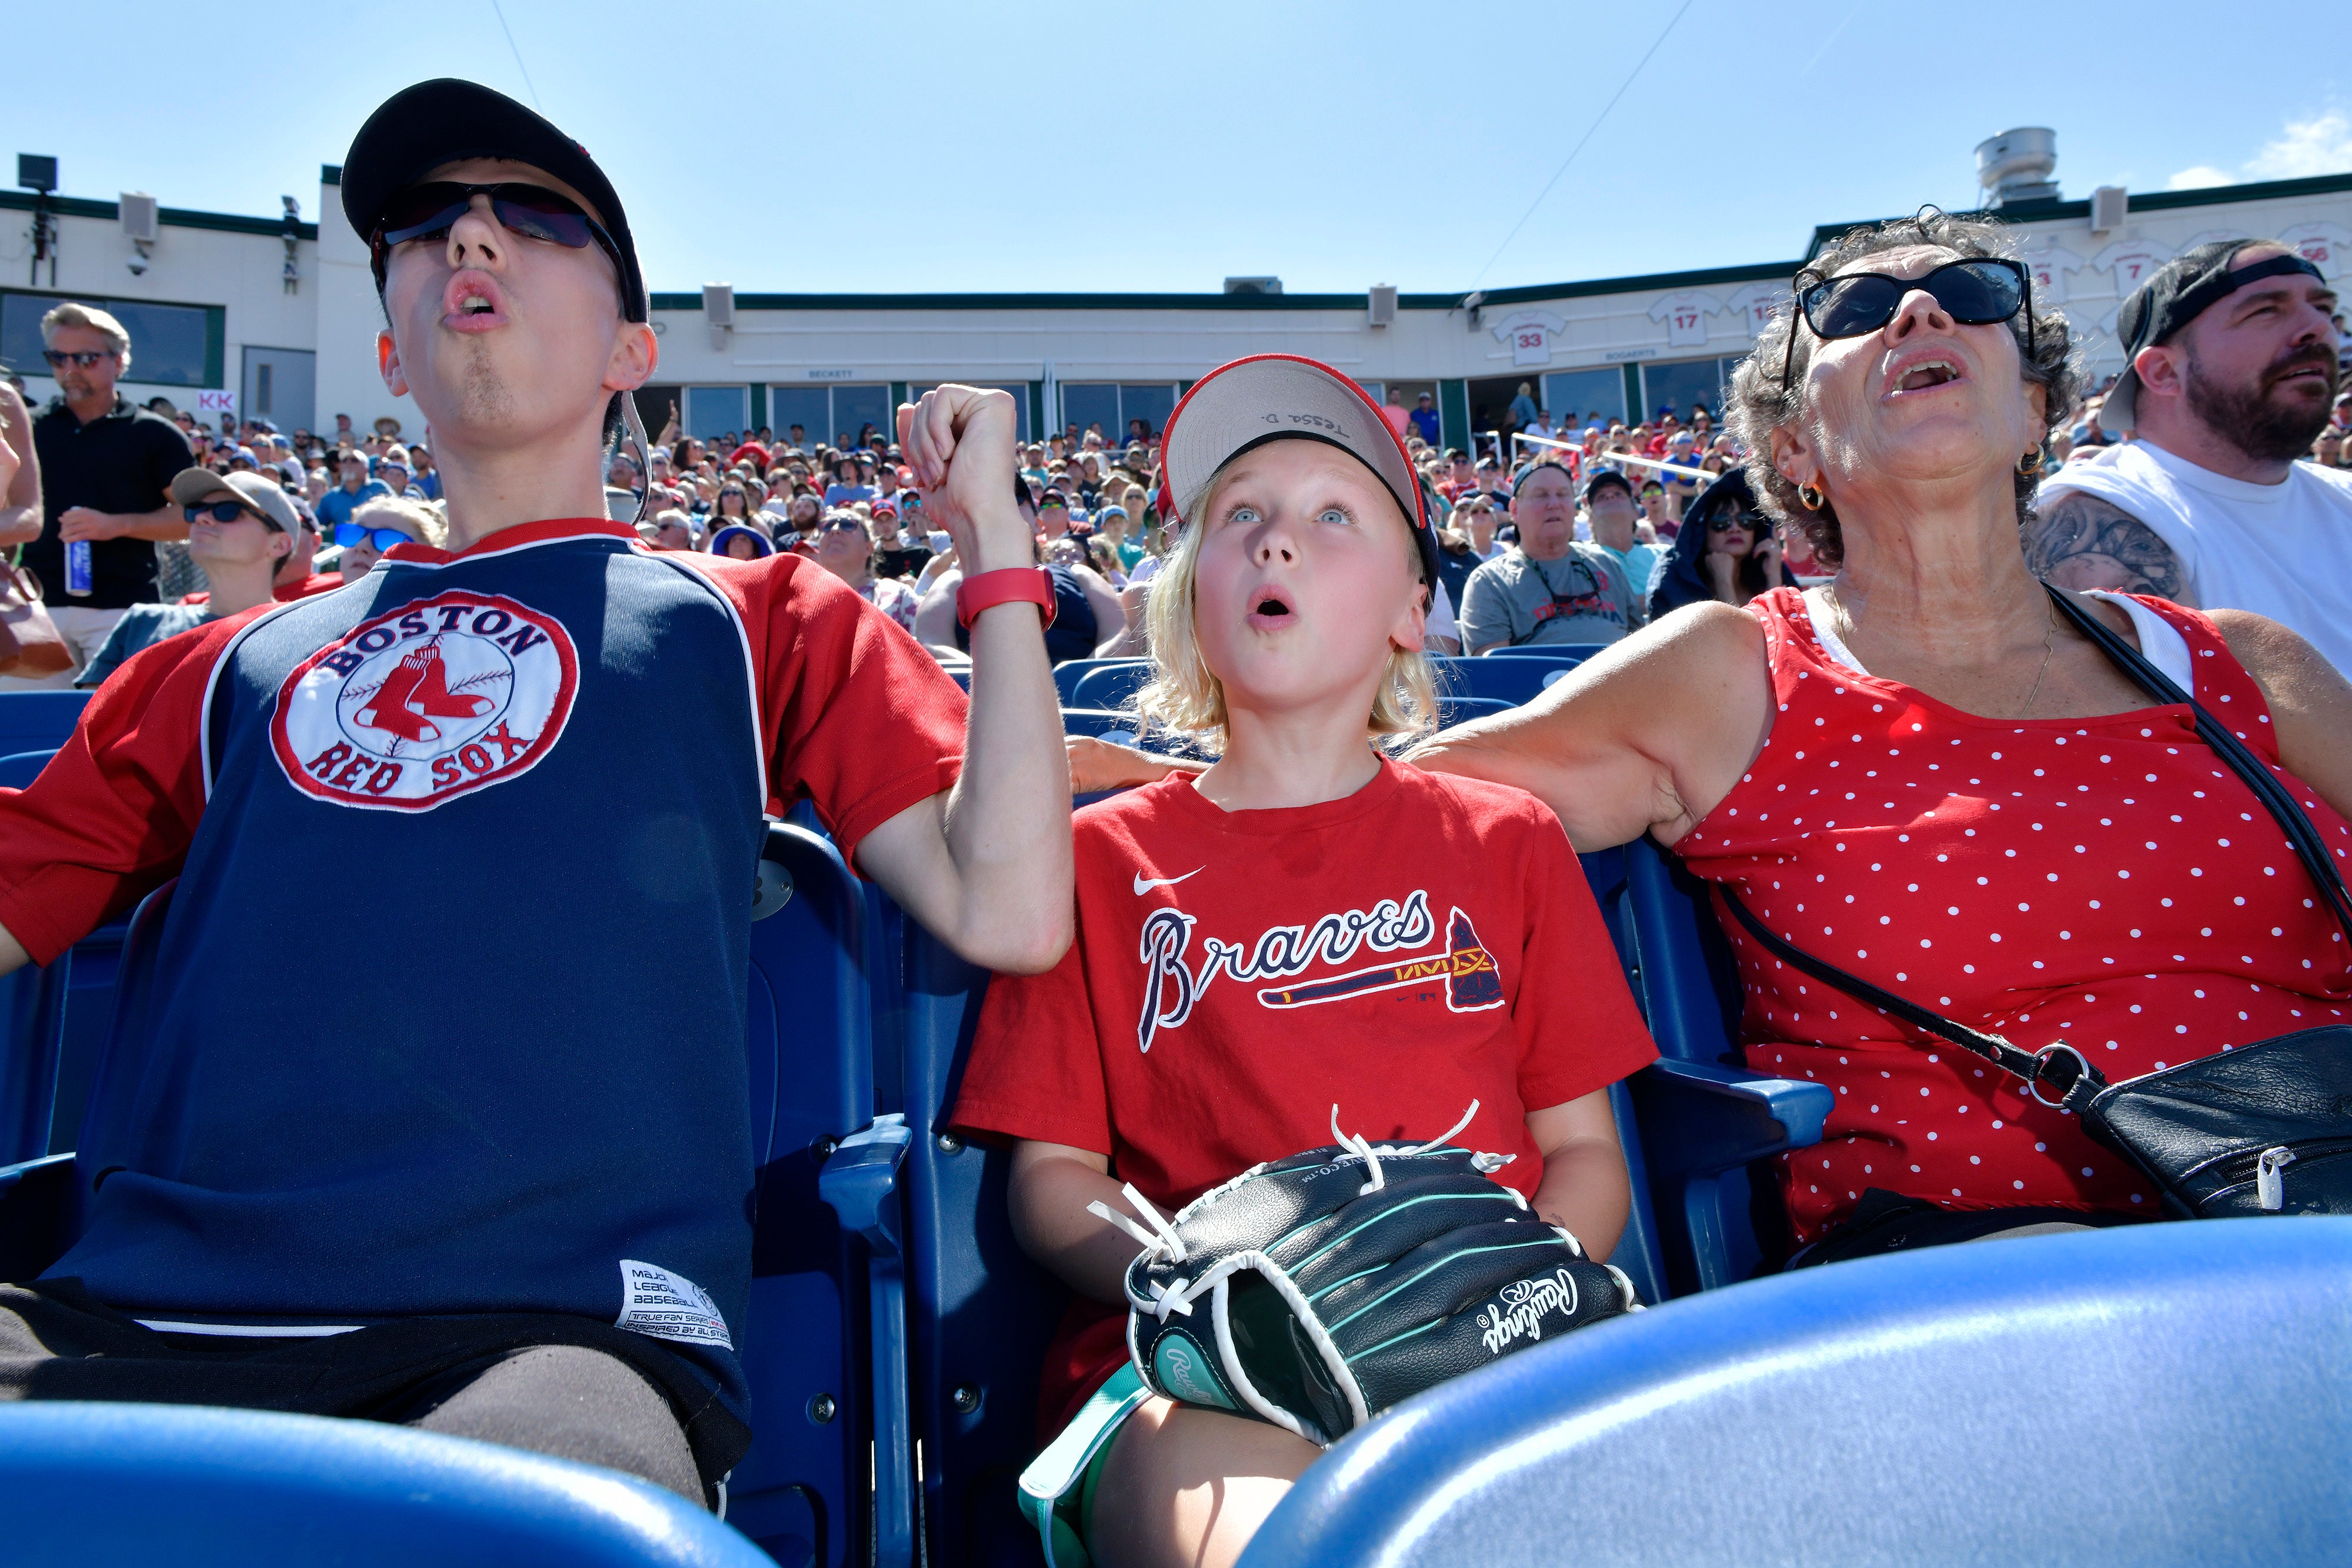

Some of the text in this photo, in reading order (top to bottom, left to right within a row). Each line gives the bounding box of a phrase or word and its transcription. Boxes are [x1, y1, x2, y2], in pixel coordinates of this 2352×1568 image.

[2129, 265, 2141, 279] 7
[1675, 314, 1698, 330] 17
[1518, 333, 1542, 348] 33
[808, 369, 853, 378] BECKETT
[1261, 413, 1350, 439] Tessa D.
[317, 605, 549, 678] BOSTON
[305, 718, 535, 795] RED SOX
[1137, 889, 1435, 1054] Braves
[627, 1322, 680, 1333] INSPIRED
